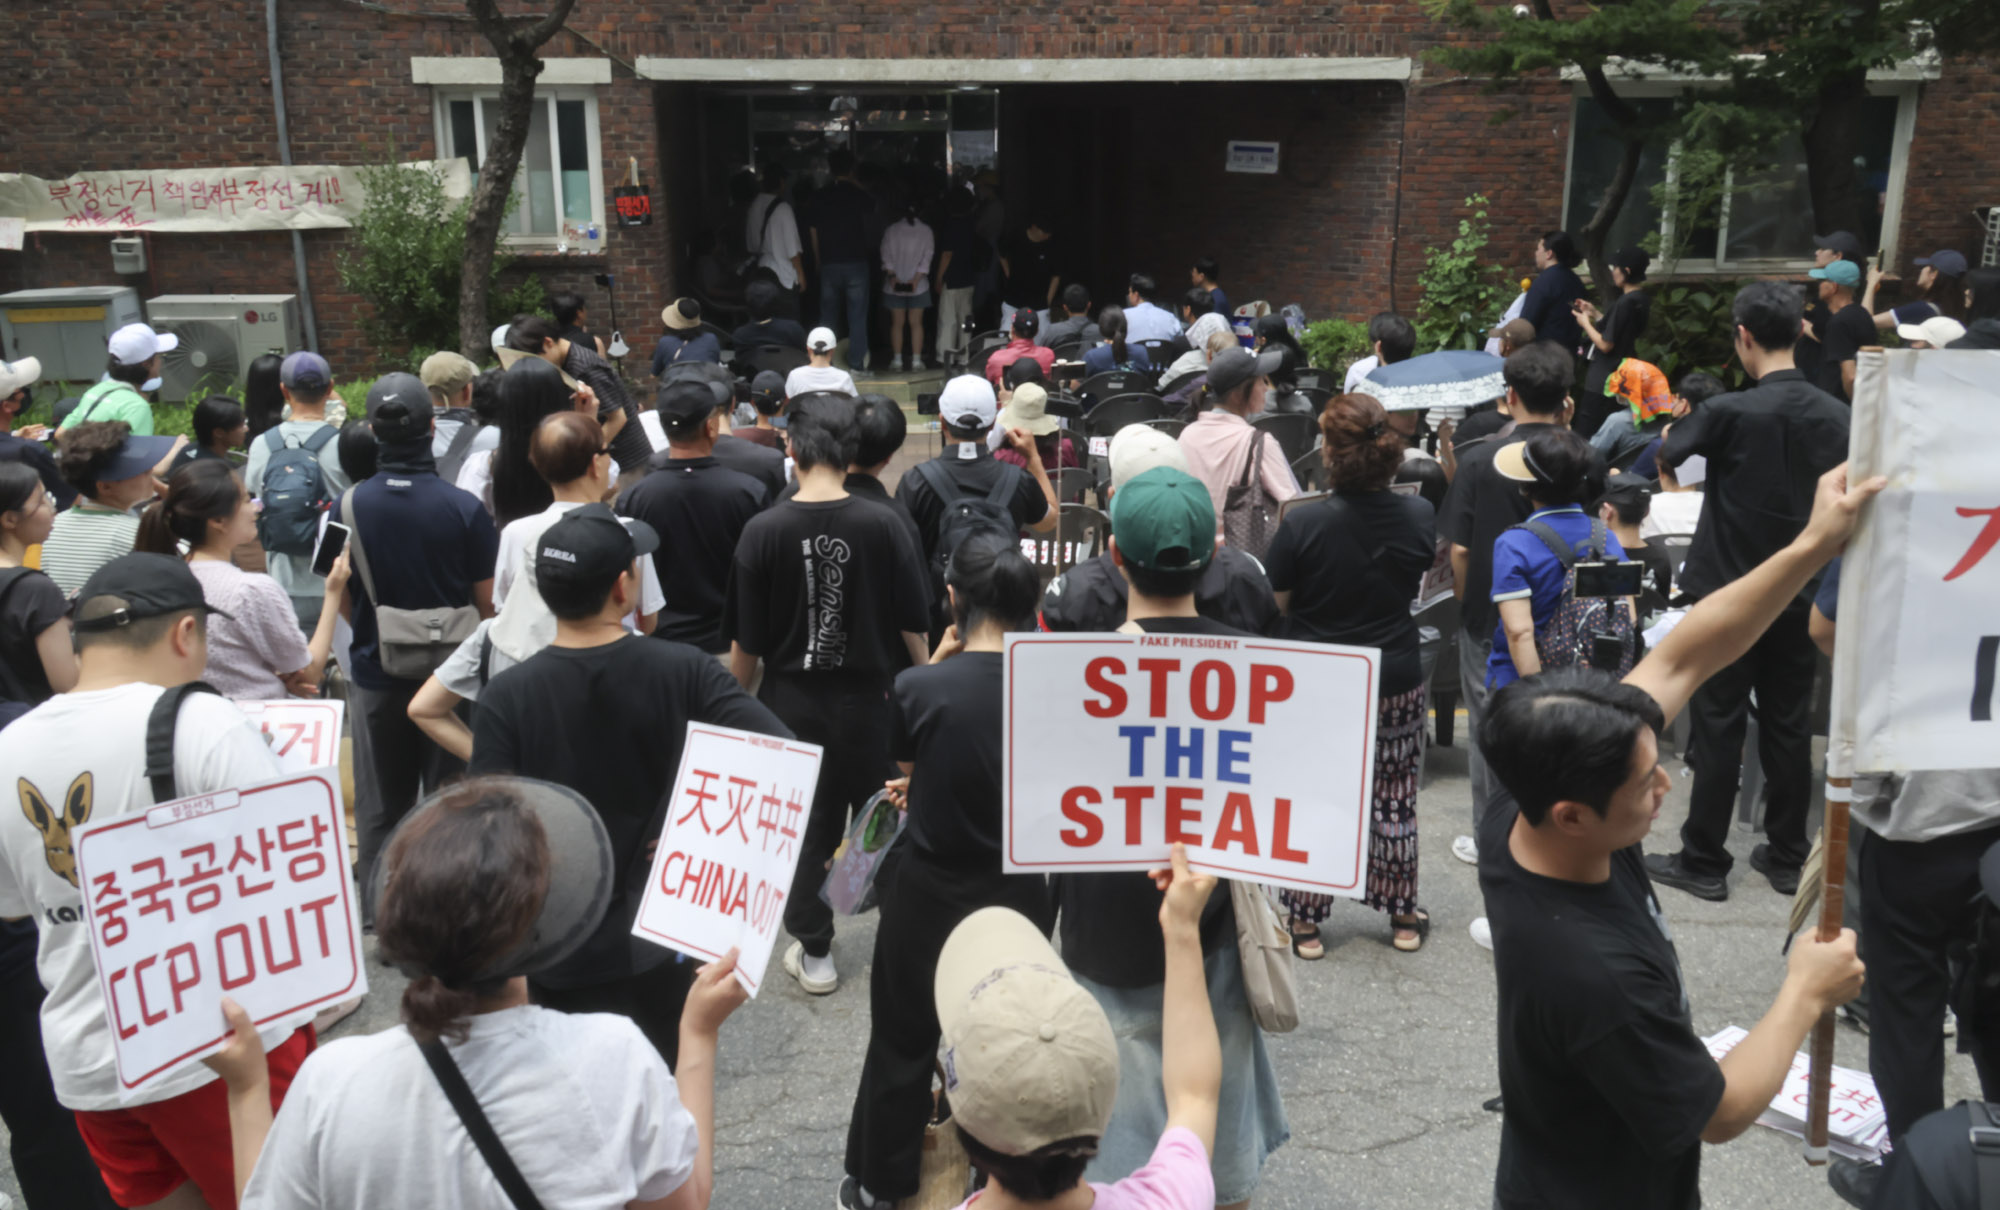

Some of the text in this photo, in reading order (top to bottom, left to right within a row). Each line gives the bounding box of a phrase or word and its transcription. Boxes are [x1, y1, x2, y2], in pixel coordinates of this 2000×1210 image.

[48, 175, 157, 213] 부정선거
[261, 311, 278, 323] LG
[1140, 635, 1239, 650] FAKE PRESIDENT
[1083, 656, 1295, 725] STOP
[1119, 725, 1253, 785] THE
[170, 798, 216, 819] 부정선거
[677, 768, 803, 862] 天灭中共
[1060, 786, 1309, 865] STEAL
[93, 814, 329, 947] 중국공산당
[660, 850, 784, 941] CHINA OUT
[109, 894, 339, 1041] CCP OUT
